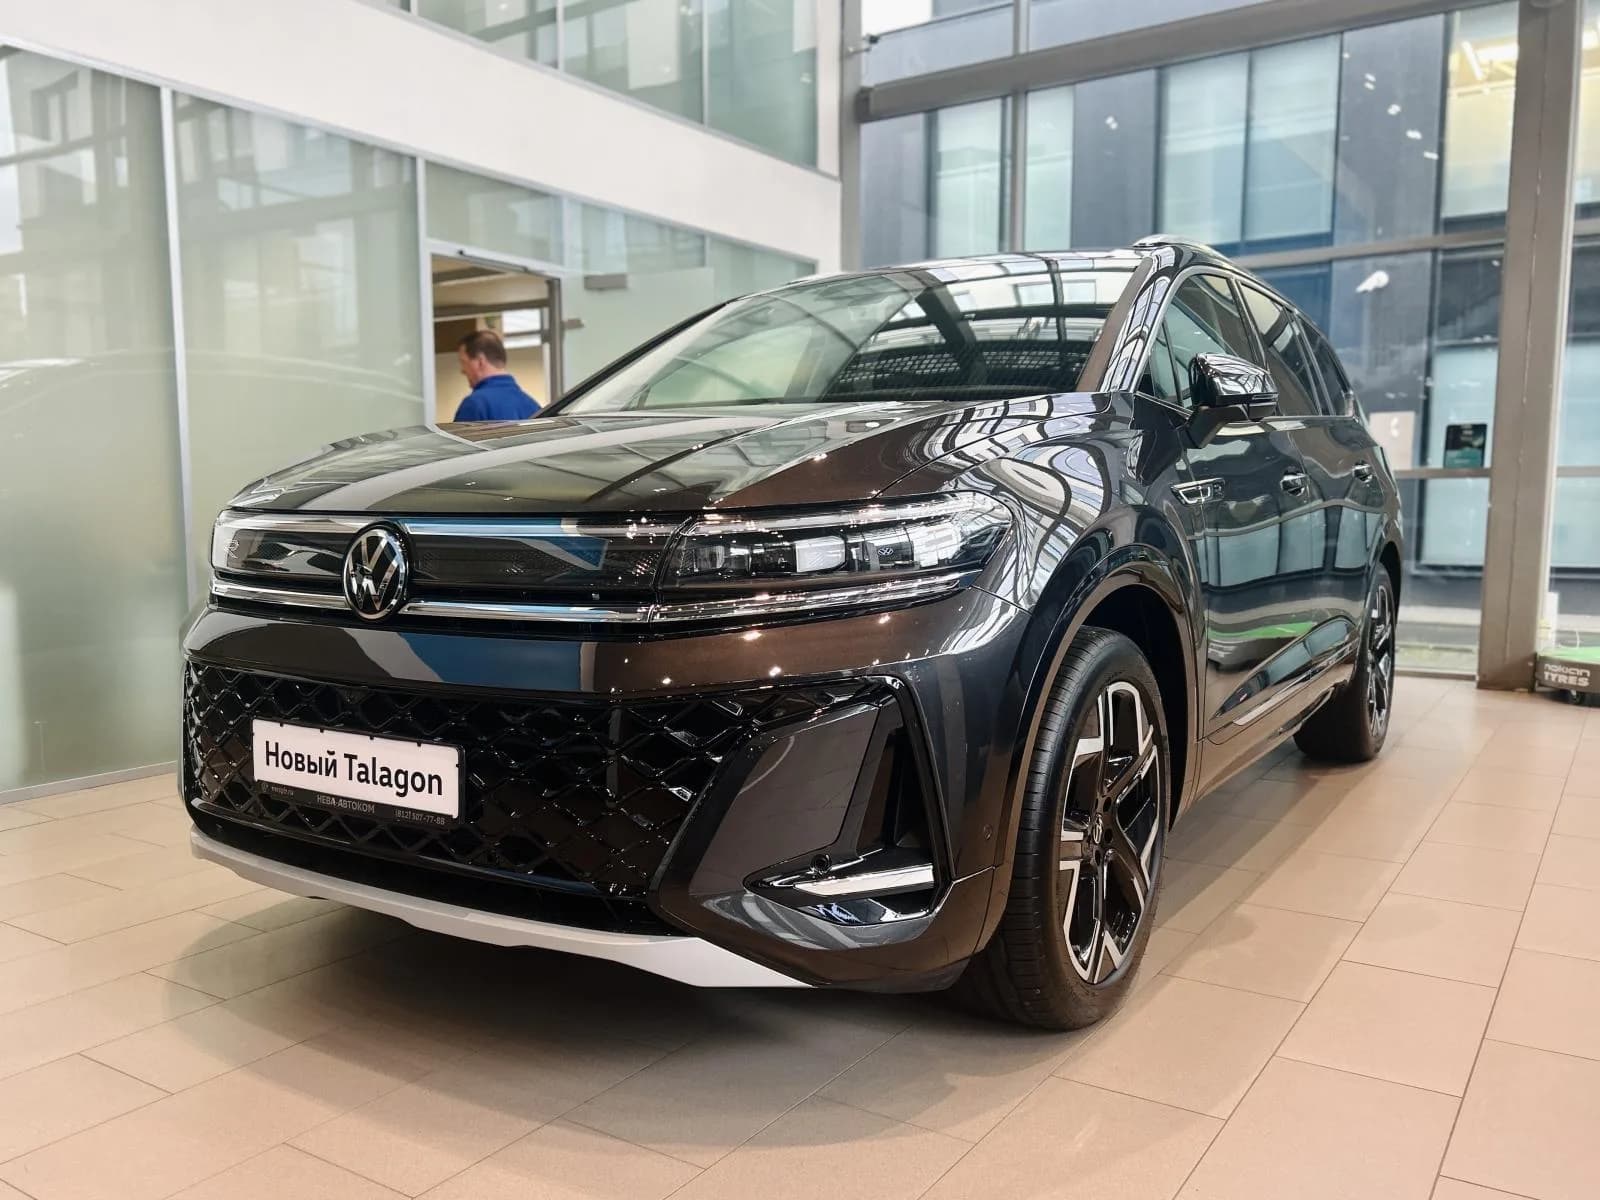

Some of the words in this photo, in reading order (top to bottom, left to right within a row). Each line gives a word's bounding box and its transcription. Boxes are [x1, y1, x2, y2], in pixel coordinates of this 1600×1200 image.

[1543, 671, 1590, 687] TYRES
[265, 740, 337, 778] Новый
[343, 753, 443, 797] Talagon
